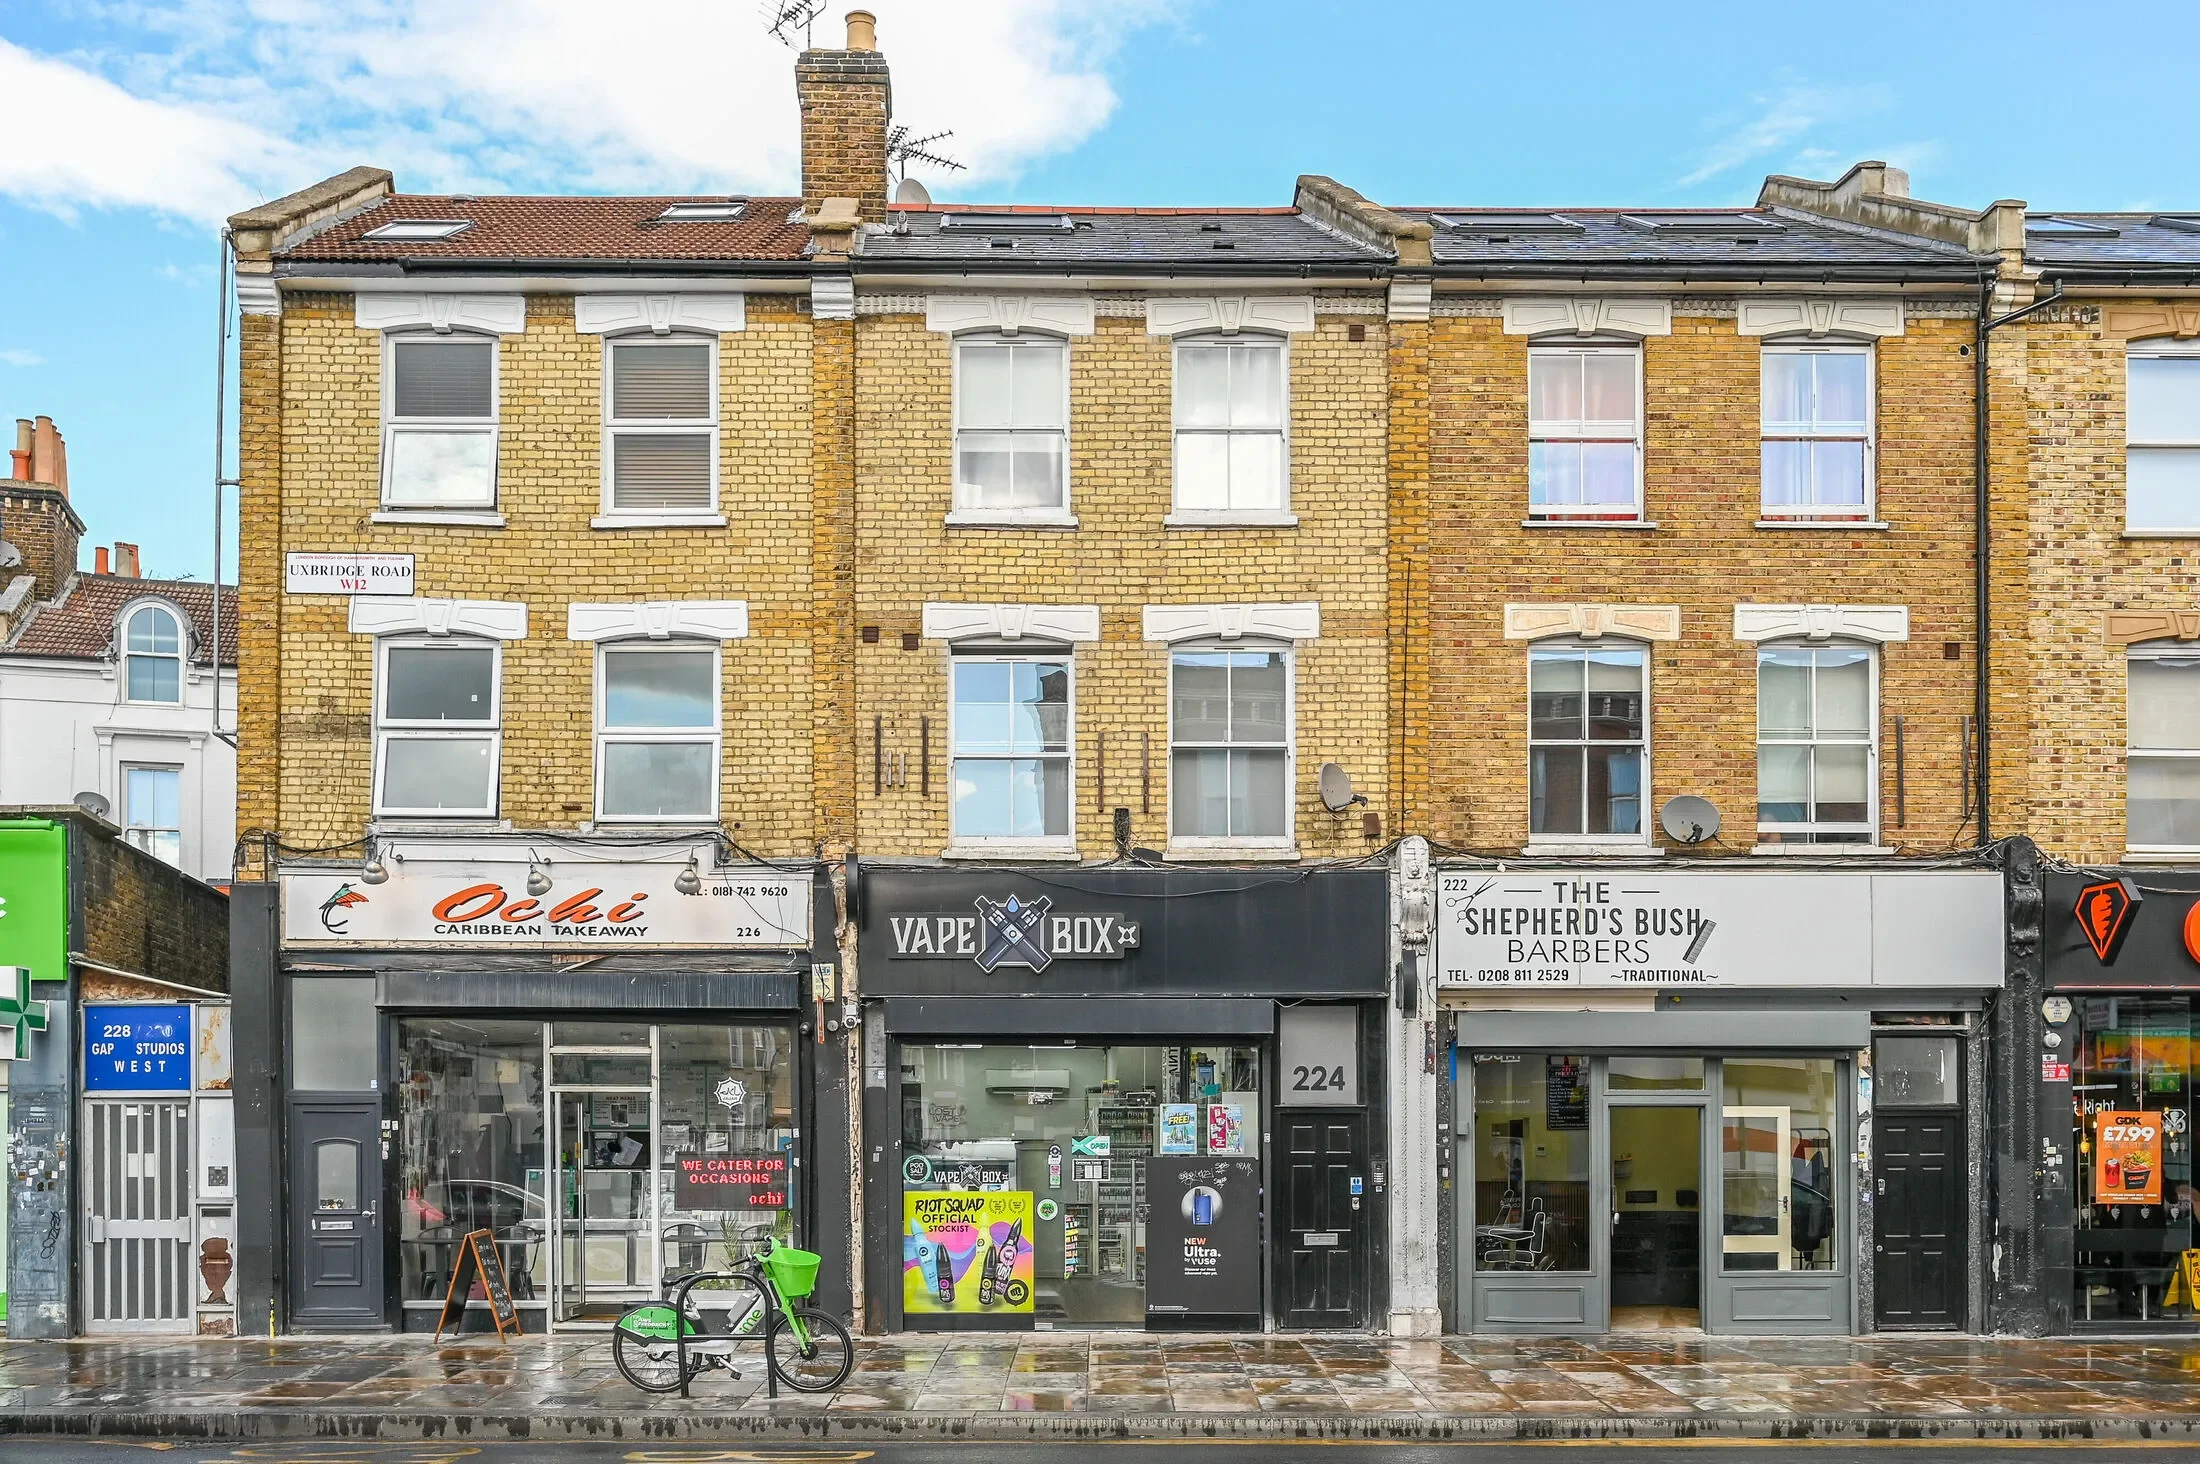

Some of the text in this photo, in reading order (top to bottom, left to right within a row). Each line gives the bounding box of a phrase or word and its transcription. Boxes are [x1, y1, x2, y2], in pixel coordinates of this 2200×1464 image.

[290, 564, 411, 577] UXBRIDGE ROAD
[340, 579, 367, 590] W12
[1444, 879, 1468, 891] 222
[712, 886, 733, 897] 0181
[737, 887, 756, 897] 742
[761, 887, 788, 897] 9620
[1552, 882, 1610, 904] THE
[432, 883, 649, 924] Ochi
[1465, 908, 1701, 936] SHEPHERD'S BUSH
[434, 924, 649, 937] CARIBBEAN TAKEAWAY
[736, 927, 761, 937] 226
[889, 917, 1115, 954] VAPE BOX
[1507, 940, 1650, 964] BARBERS
[1478, 969, 1509, 981] 0208
[1514, 969, 1532, 981] 811
[1537, 969, 1569, 981] 2529
[103, 1025, 131, 1037] 228
[92, 1043, 185, 1055] GAP STUDIOS
[1292, 1065, 1345, 1091] 224
[2115, 1116, 2142, 1125] GDK
[2103, 1126, 2156, 1142] £7.99
[1090, 1142, 1108, 1150] OPEN
[682, 1160, 784, 1171] WE CATER FOR
[689, 1173, 771, 1184] OCCASIONS
[934, 1171, 1002, 1183] VAPE BOX
[749, 1191, 785, 1205] ochi
[915, 1199, 944, 1213] RIOT
[945, 1198, 985, 1213] SQUAD
[922, 1214, 977, 1223] OFFICIAL
[928, 1225, 969, 1233] STOCKIST
[1184, 1237, 1206, 1245] NEW
